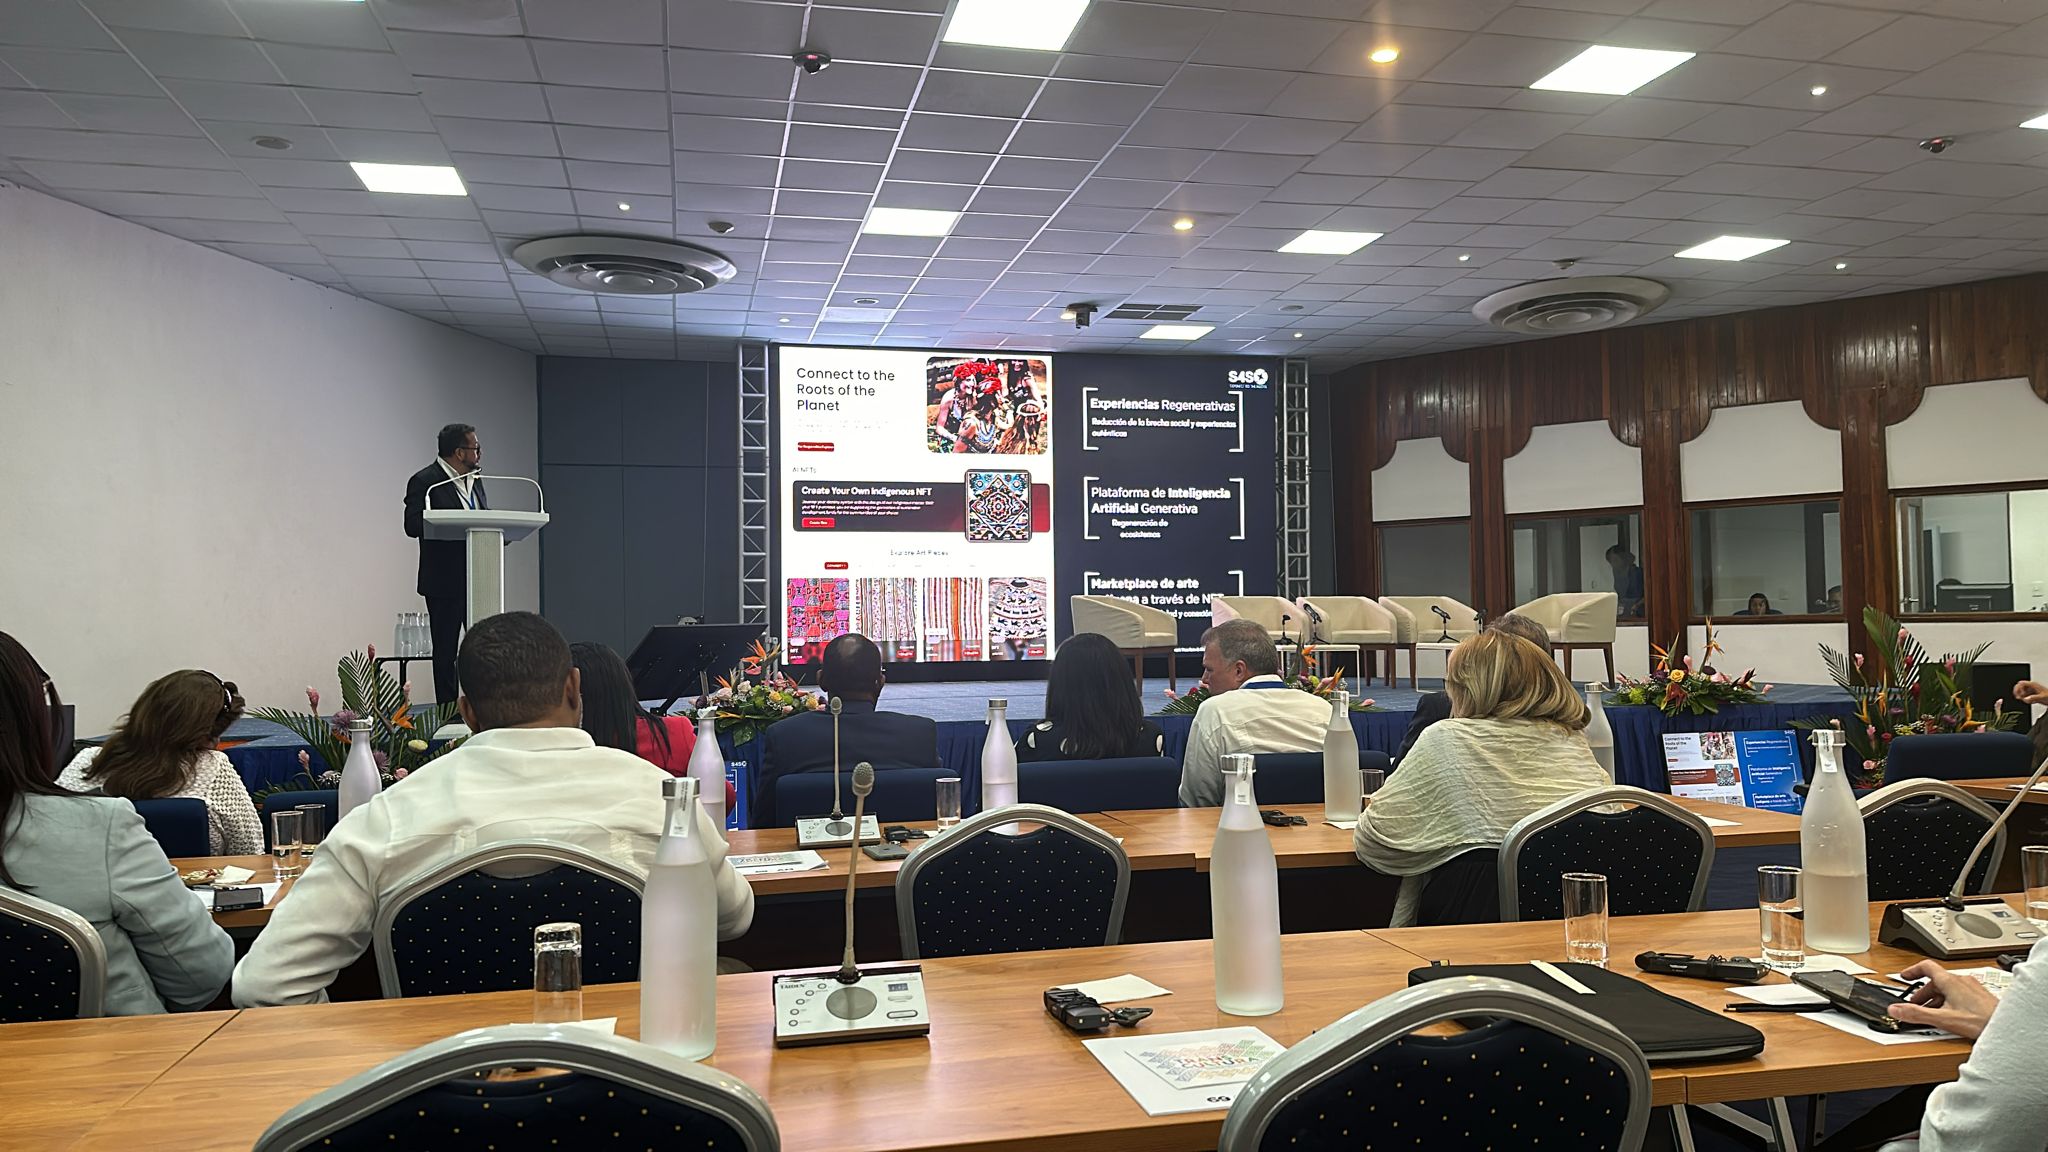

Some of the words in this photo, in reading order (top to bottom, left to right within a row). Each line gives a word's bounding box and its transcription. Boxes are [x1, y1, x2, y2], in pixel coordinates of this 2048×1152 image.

[796, 367, 854, 380] Connect
[857, 369, 871, 381] to
[873, 369, 895, 381] the
[796, 383, 835, 396] Roots
[837, 384, 851, 396] of
[853, 385, 876, 397] the
[796, 399, 840, 411] Planet
[1090, 398, 1160, 410] Experiencias
[1161, 399, 1236, 412] Regenerativas
[1091, 417, 1127, 426] Reducción
[1127, 418, 1138, 426] de
[1138, 418, 1146, 426] la
[1146, 418, 1170, 427] brecha
[1170, 419, 1191, 427] social
[1190, 420, 1195, 429] y
[1195, 420, 1237, 429] experiencias
[801, 486, 831, 495] Create
[831, 486, 851, 495] Your
[851, 487, 870, 496] Own
[871, 487, 916, 497] Indigenous
[916, 487, 933, 496] NFT
[1091, 487, 1150, 498] Plataforma
[1151, 487, 1166, 498] de
[1168, 487, 1231, 500] Inteligencia
[1091, 502, 1139, 514] Artificial
[1140, 503, 1199, 514] Generativa
[1111, 518, 1158, 528] Regeneración
[1158, 518, 1169, 527] de
[1091, 578, 1159, 590] Marketplace
[1160, 578, 1176, 589] de
[1177, 578, 1200, 589] arte
[1141, 595, 1149, 605] a
[1150, 593, 1184, 605] través
[1185, 593, 1200, 605] de
